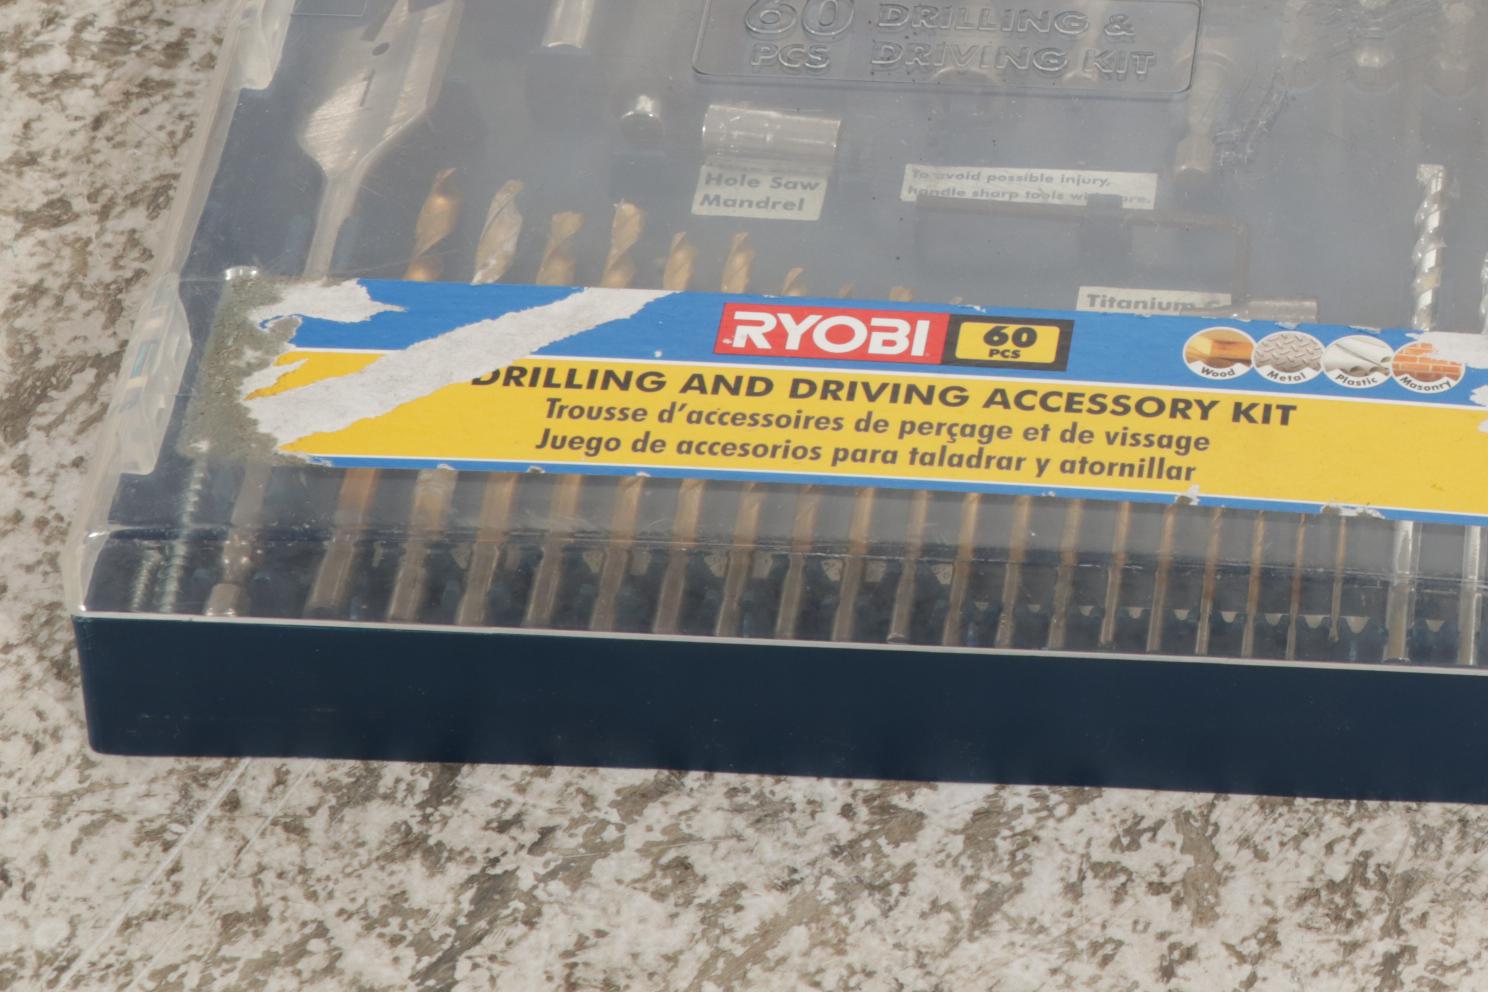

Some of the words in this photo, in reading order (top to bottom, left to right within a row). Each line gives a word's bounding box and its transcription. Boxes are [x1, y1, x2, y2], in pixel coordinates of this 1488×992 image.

[877, 3, 1090, 36] DRILLING
[1103, 12, 1136, 38] &
[750, 42, 831, 72] PCS
[870, 40, 1070, 73] DRIVING
[1081, 47, 1157, 75] KIT
[704, 172, 761, 188] Hole
[769, 176, 820, 190] Saw
[987, 172, 1054, 186] possible
[1060, 174, 1111, 188] injury,
[699, 193, 805, 211] Mandrel
[972, 188, 1019, 201] sharp
[1025, 189, 1064, 201] tools
[731, 310, 930, 357] RYOBI
[983, 325, 1038, 348] 60
[988, 348, 1022, 359] PCS
[1200, 366, 1236, 378] Wood
[1266, 370, 1307, 382] Metal
[1335, 374, 1379, 386] Plastic
[1399, 376, 1452, 392] Masonry
[679, 372, 775, 398] AND
[788, 377, 970, 408] DRIVING
[982, 388, 1221, 421] ACCESSORY
[1231, 401, 1298, 426] KIT
[546, 397, 649, 423] Trousse
[657, 401, 844, 431] d'accessoires
[854, 410, 890, 434] de
[897, 419, 1013, 445] perçage
[1022, 423, 1050, 442] et
[1059, 421, 1095, 444] de
[1104, 427, 1211, 456] vissage
[535, 428, 622, 457] Juego
[631, 431, 667, 454] de
[675, 438, 823, 461] accesorios
[831, 446, 899, 467] para
[908, 445, 1027, 472] taladrar
[1035, 457, 1051, 478] y
[1059, 456, 1197, 481] atornillar
